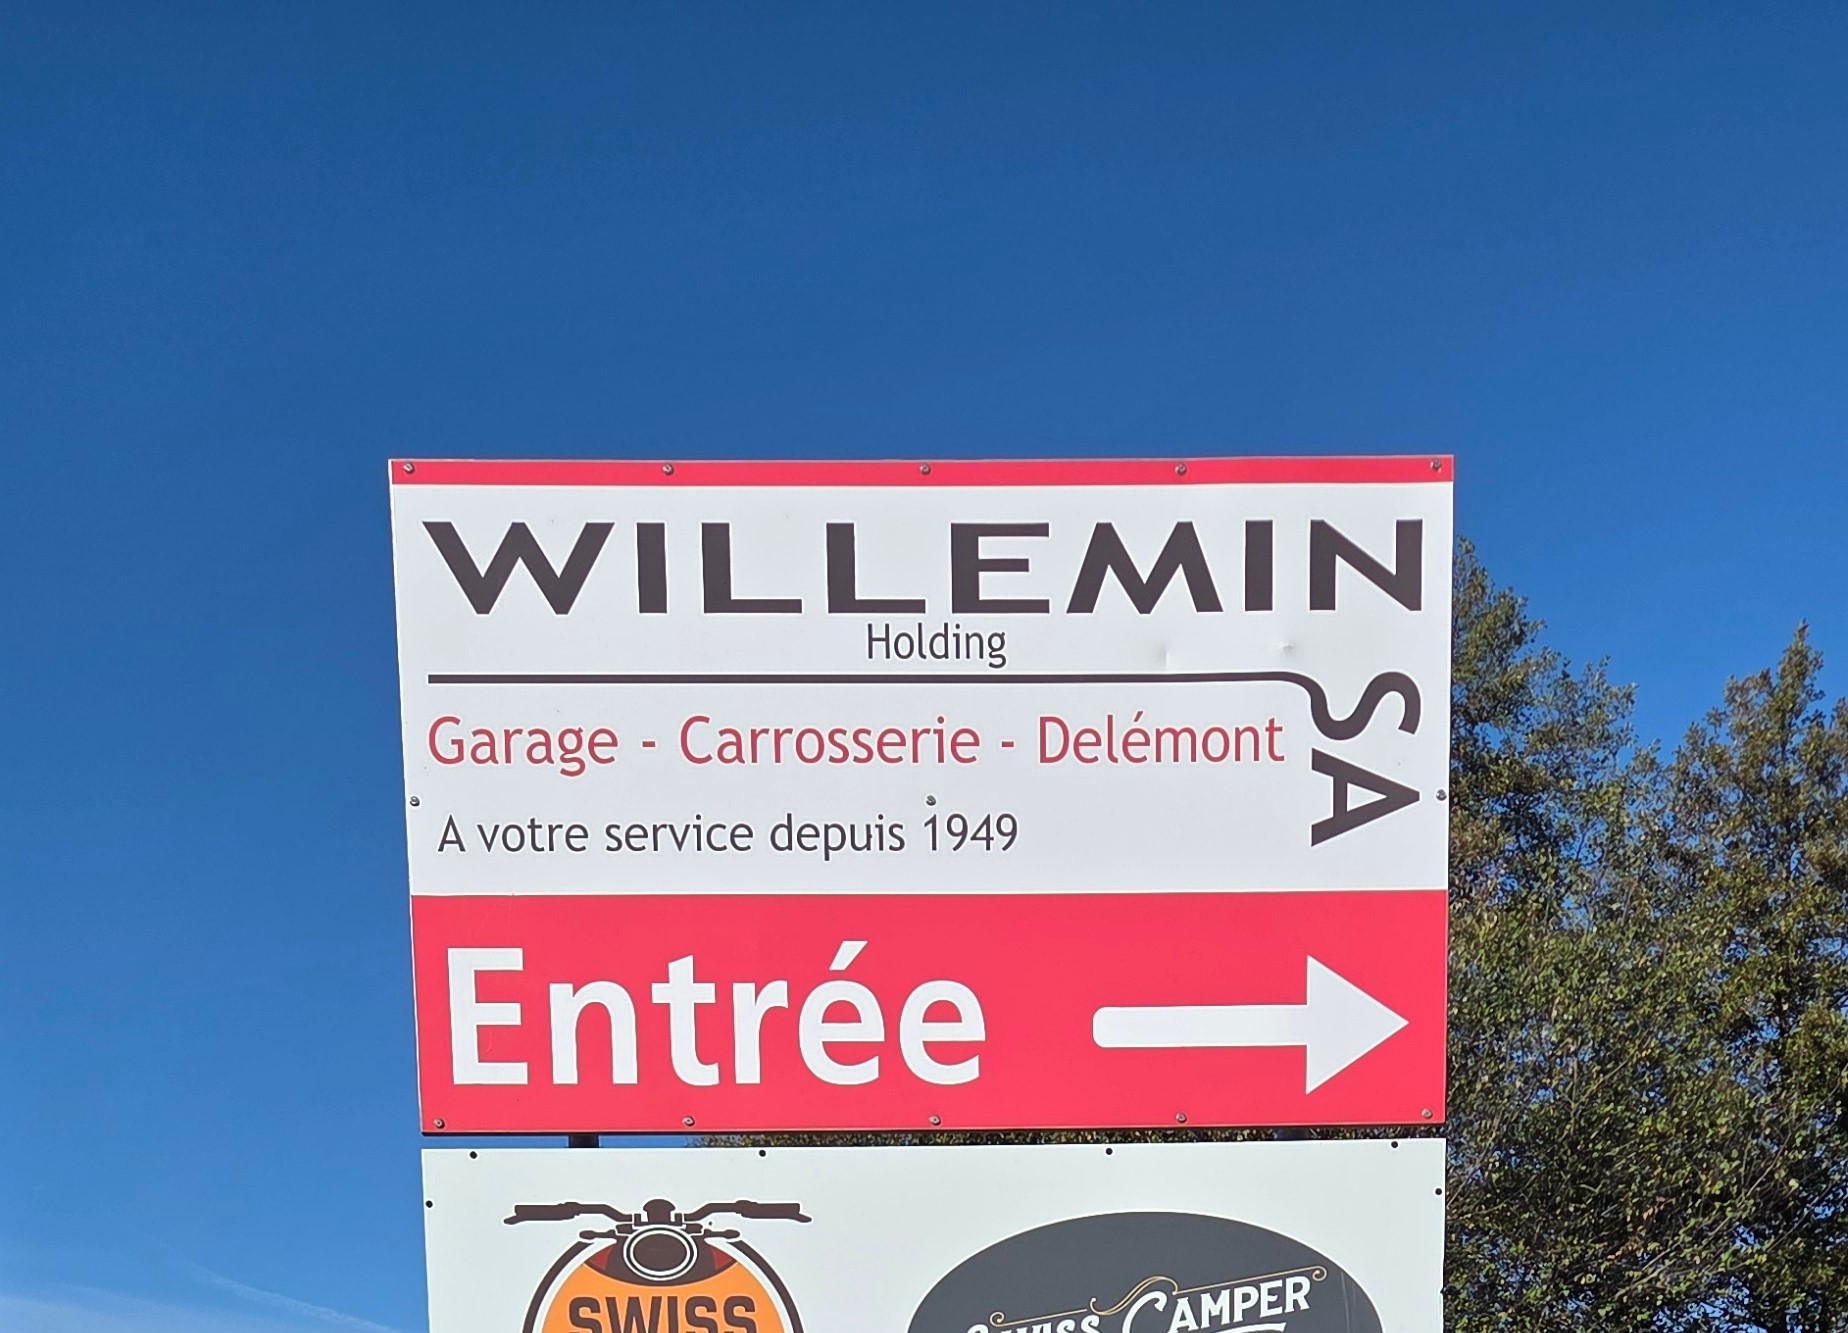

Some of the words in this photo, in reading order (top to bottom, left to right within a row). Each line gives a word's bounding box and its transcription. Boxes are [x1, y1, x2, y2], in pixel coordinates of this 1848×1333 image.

[422, 519, 1424, 616] WILLEMIN
[866, 622, 1007, 670] Holding
[428, 715, 619, 778] Garage
[641, 740, 656, 749] -
[679, 715, 981, 765] Carrosserie
[1000, 740, 1015, 749] -
[1038, 711, 1285, 765] Delémont
[1309, 670, 1422, 848] SA
[436, 813, 466, 853] A
[475, 816, 590, 853] votre
[604, 813, 755, 853] service
[769, 811, 907, 863] depuis
[923, 812, 1019, 853] 1949
[446, 940, 987, 1087] Entrée
